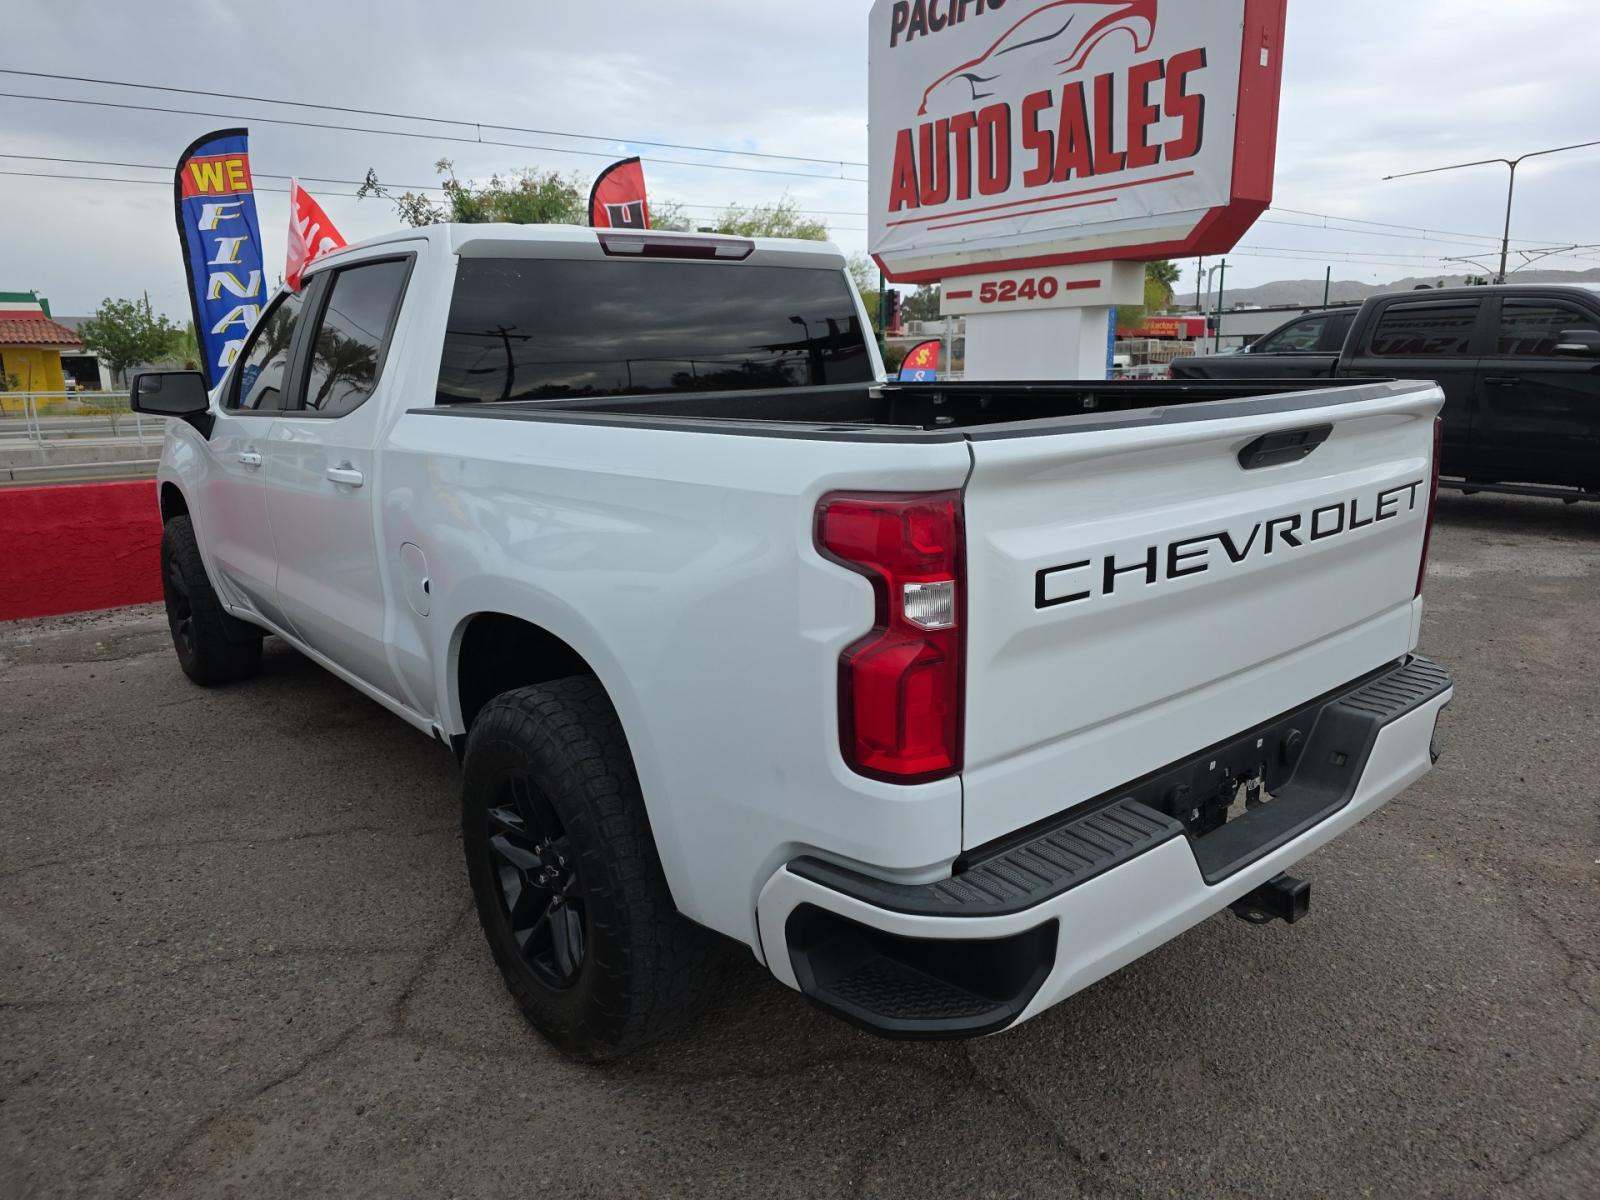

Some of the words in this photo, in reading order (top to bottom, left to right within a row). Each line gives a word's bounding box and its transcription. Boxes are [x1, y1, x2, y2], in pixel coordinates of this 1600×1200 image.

[888, 102, 1011, 212] AUTO
[1021, 47, 1208, 188] SALES
[190, 160, 248, 192] WE
[979, 276, 1058, 303] 5240
[1035, 479, 1424, 609] CHEVROLET
